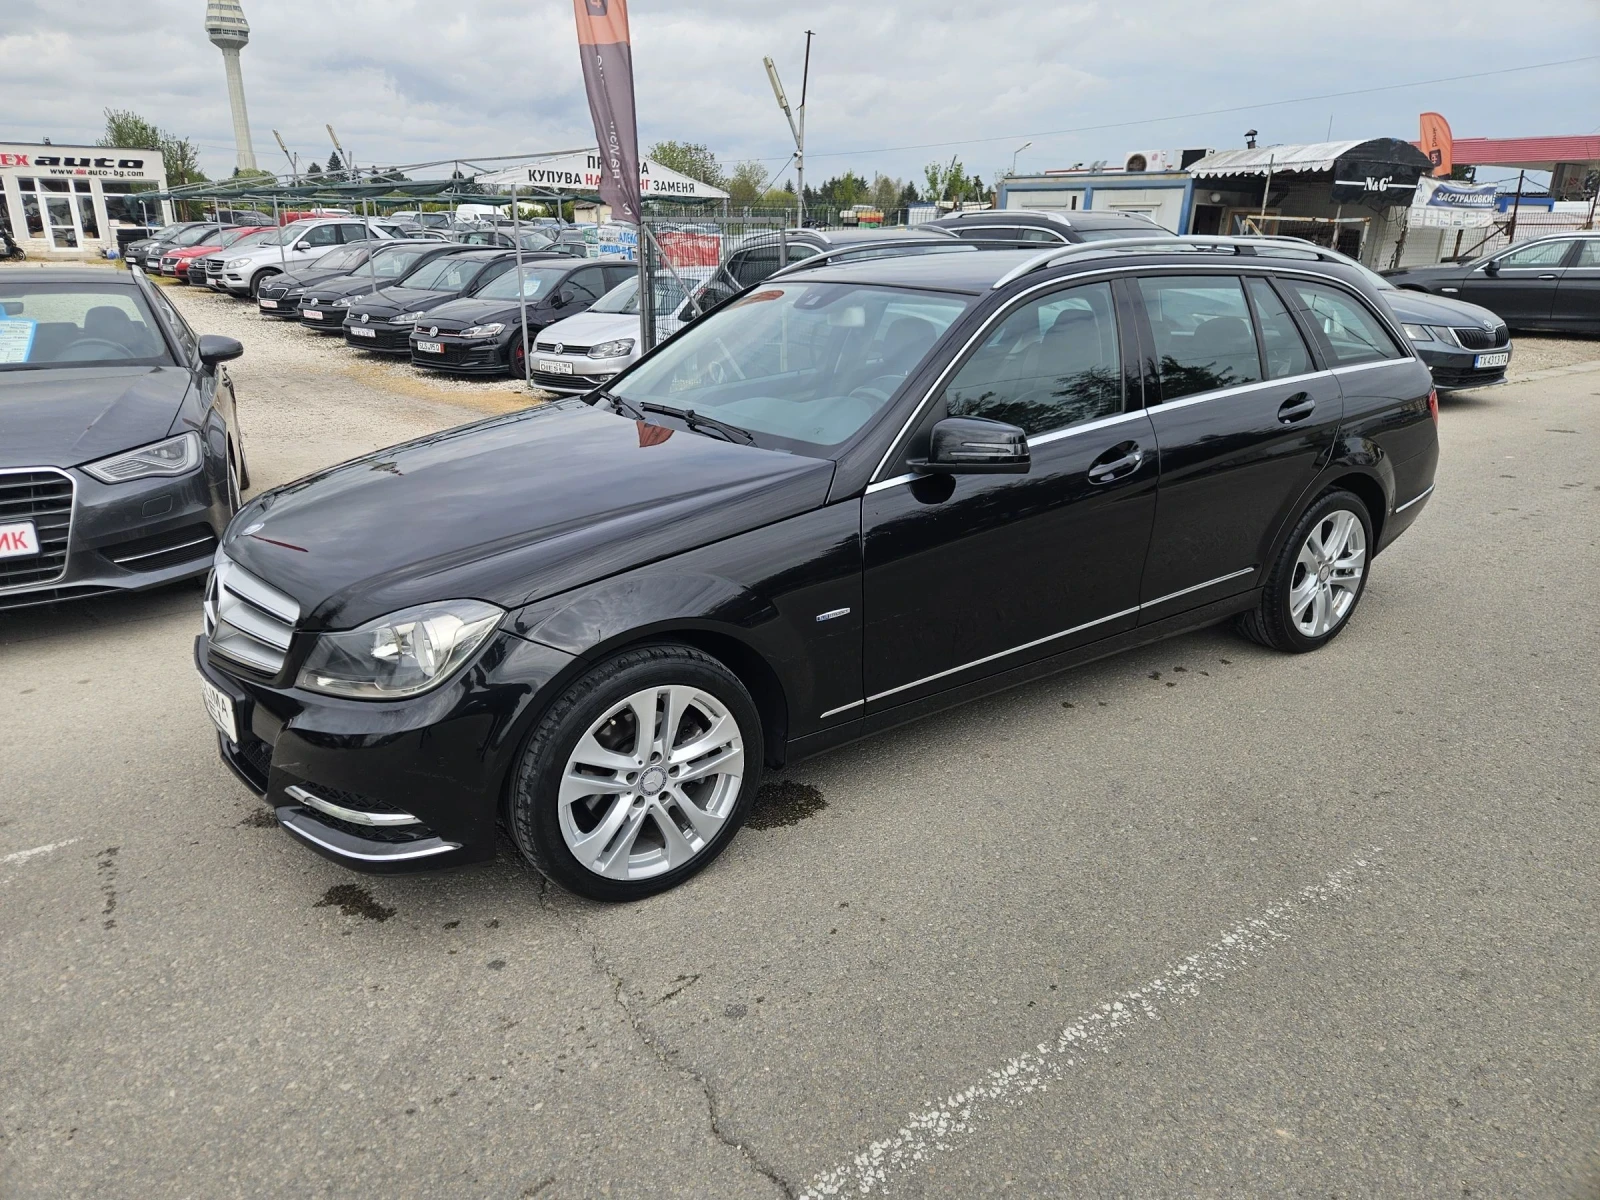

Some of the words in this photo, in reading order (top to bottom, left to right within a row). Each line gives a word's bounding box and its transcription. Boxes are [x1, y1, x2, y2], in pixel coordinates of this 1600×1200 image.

[34, 156, 144, 169] auto
[528, 169, 582, 185] КУПУВА
[653, 180, 695, 193] ЗАМЕНЯ
[1436, 191, 1493, 204] ЗАСТРАХОВКИ
